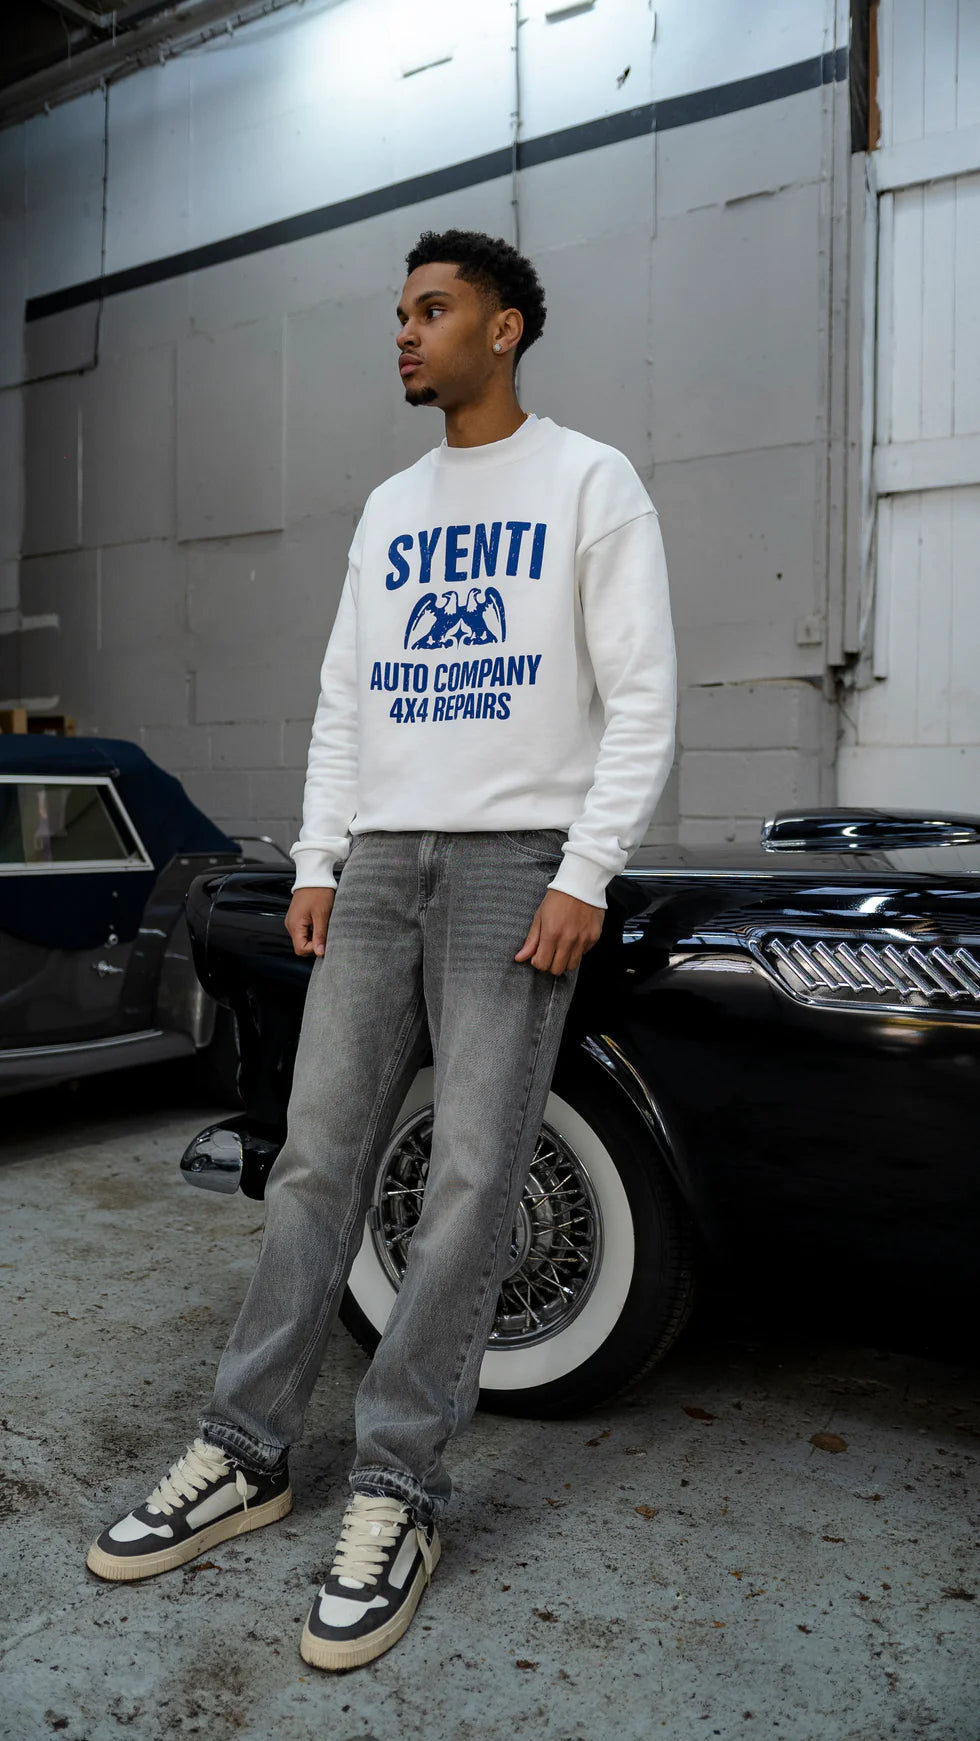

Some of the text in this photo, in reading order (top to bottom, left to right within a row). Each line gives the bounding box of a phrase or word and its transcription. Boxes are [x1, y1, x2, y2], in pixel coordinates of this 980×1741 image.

[385, 521, 547, 591] SYENTI
[370, 654, 542, 693] AUTO COMPANY
[389, 692, 511, 723] 4X4 REPAIRS
